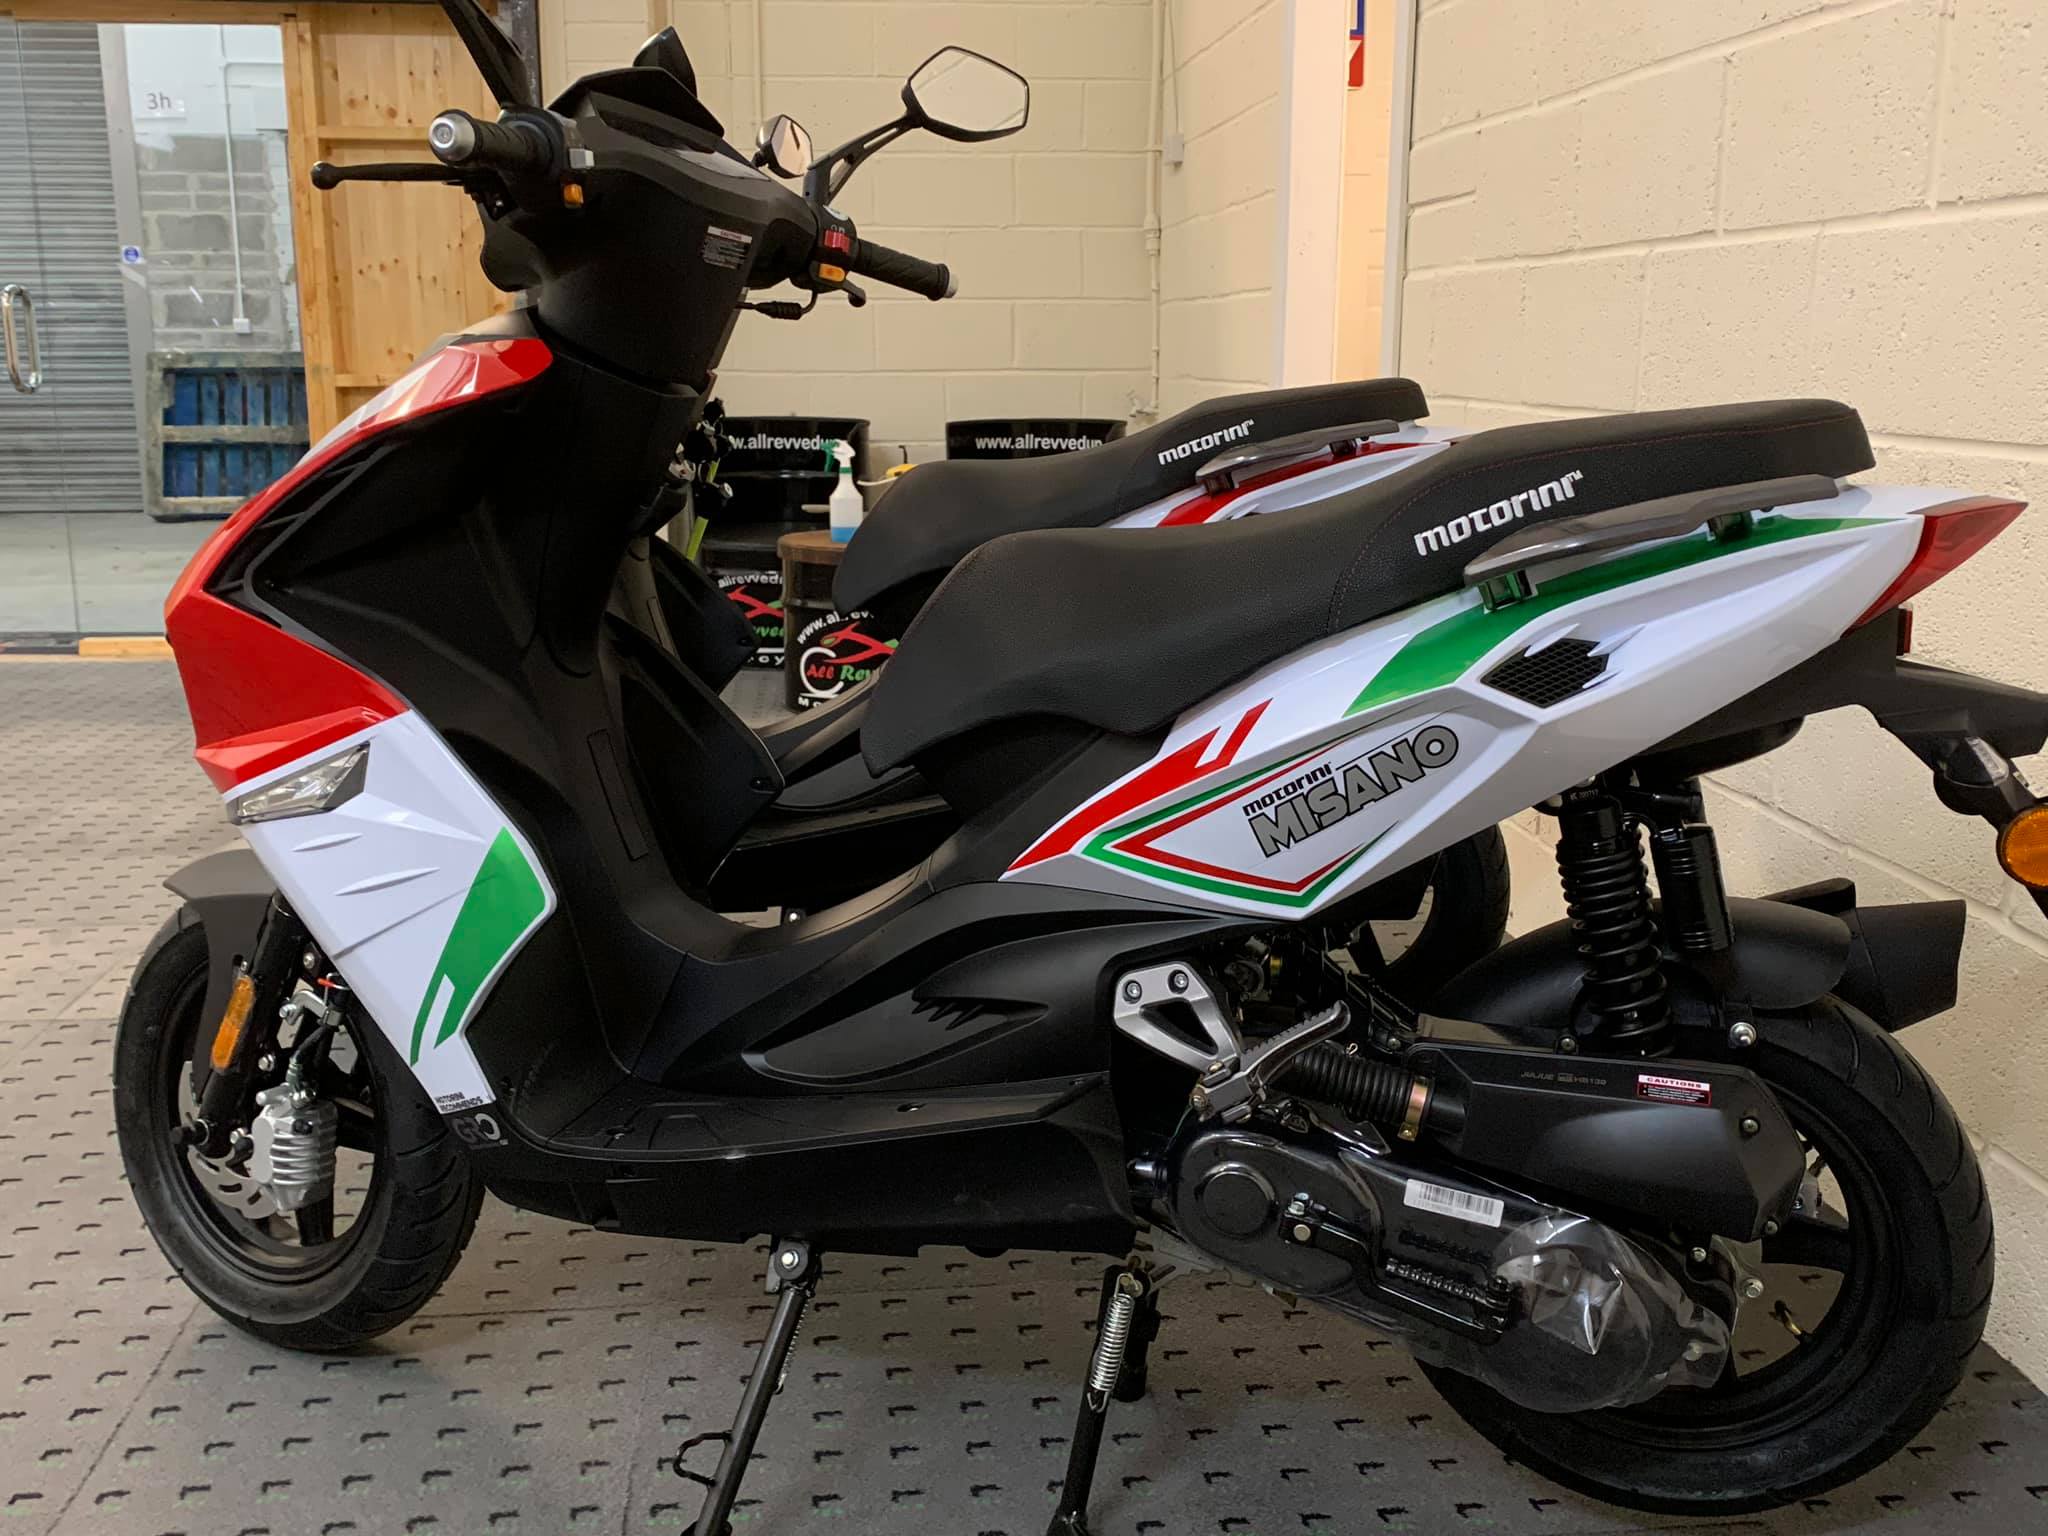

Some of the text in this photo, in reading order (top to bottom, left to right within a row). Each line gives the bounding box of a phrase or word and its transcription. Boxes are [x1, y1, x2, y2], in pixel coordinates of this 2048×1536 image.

[146, 92, 172, 111] 3h
[1248, 724, 1459, 858] MISANO
[1646, 1077, 1703, 1089] CAUTIONS
